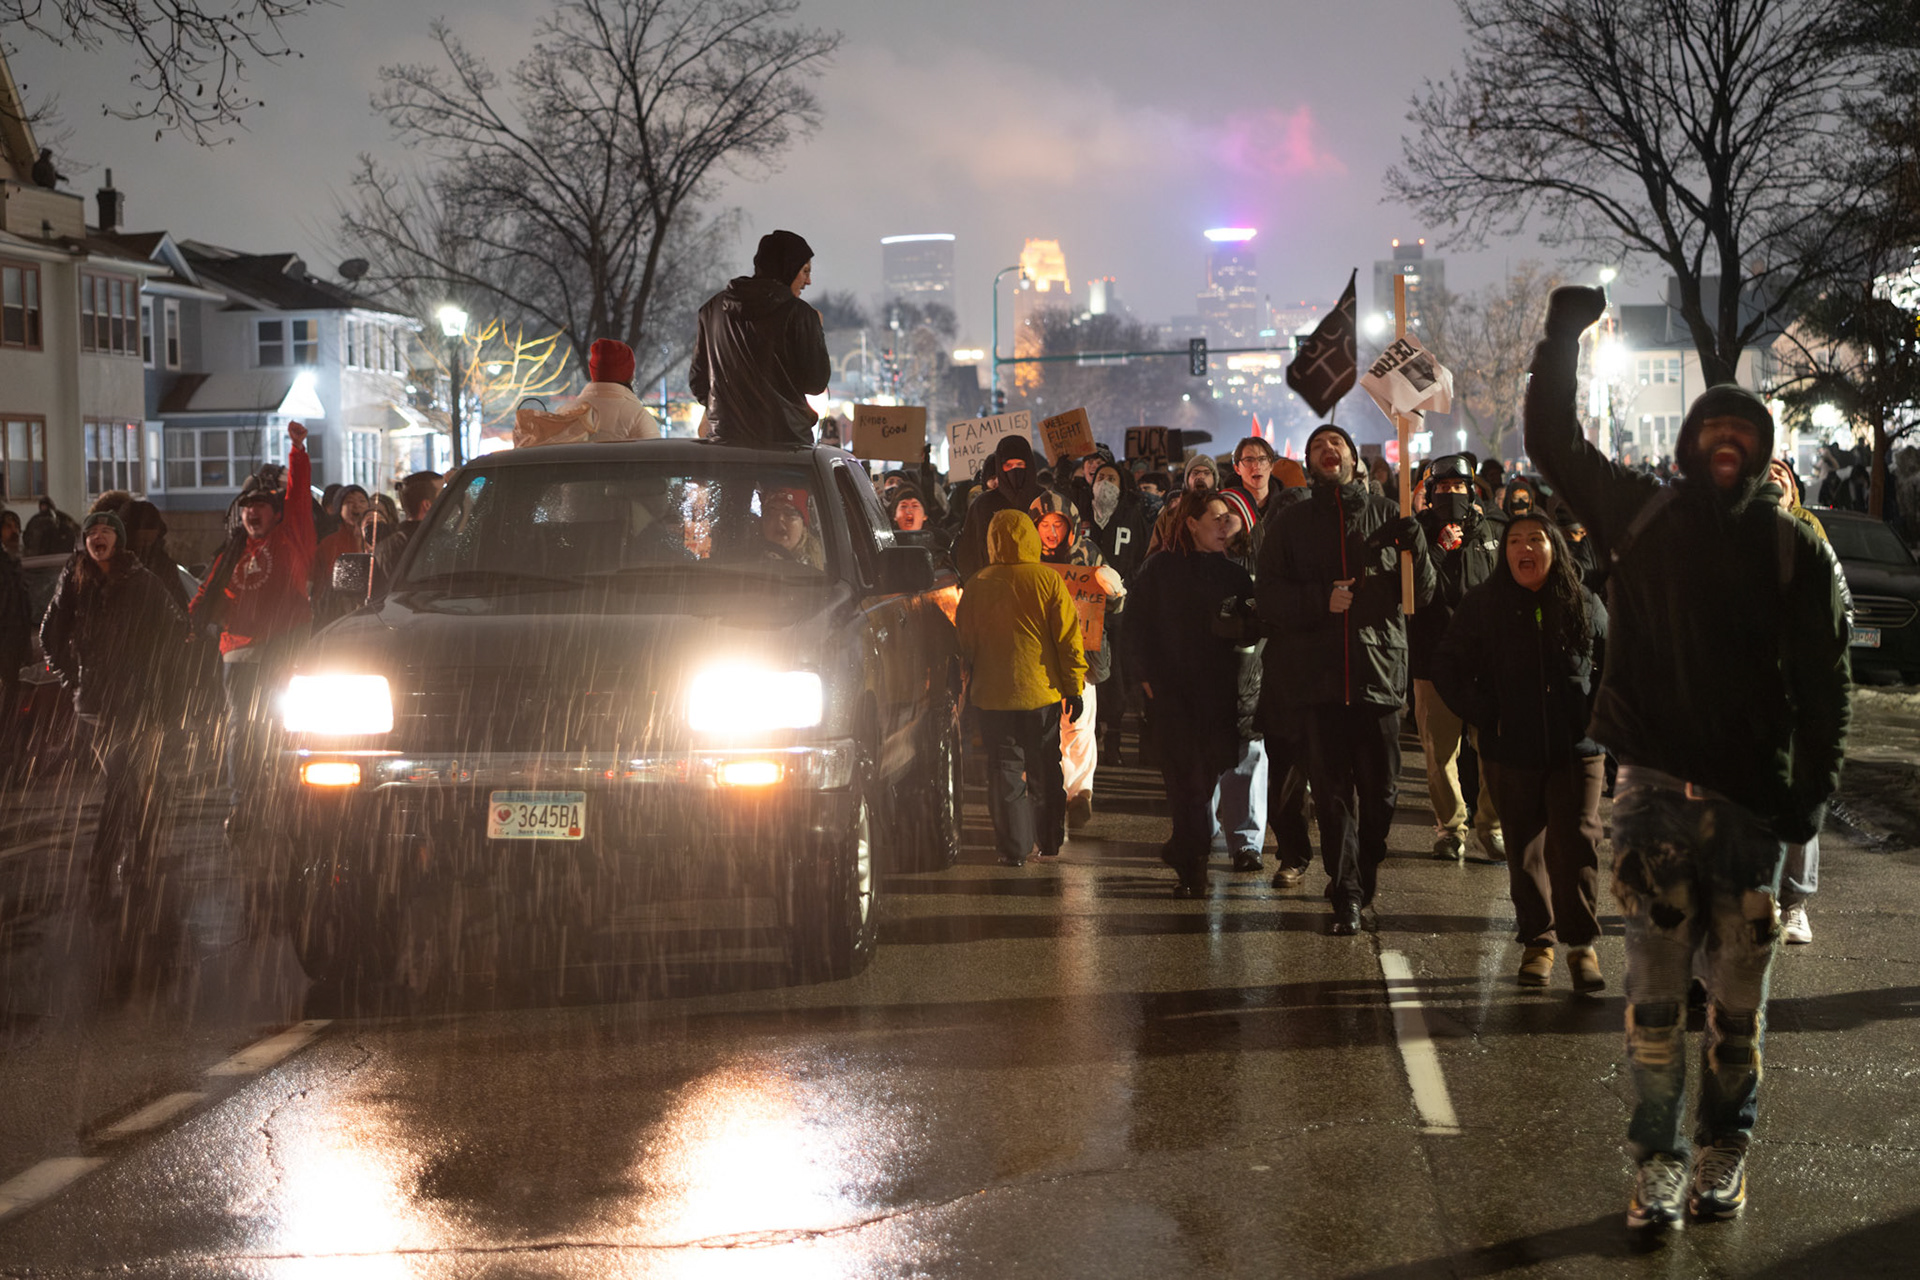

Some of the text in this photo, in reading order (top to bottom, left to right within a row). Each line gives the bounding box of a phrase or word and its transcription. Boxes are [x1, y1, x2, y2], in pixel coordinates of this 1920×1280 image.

[1389, 338, 1419, 362] CE
[882, 423, 907, 438] Good
[952, 412, 1029, 444] FAMILIES
[1047, 421, 1081, 443] FIGHT
[953, 442, 985, 458] HAVE
[1125, 428, 1167, 457] FUCK
[1114, 526, 1131, 556] P
[1064, 570, 1090, 583] NO
[518, 804, 579, 828] 3645BA
